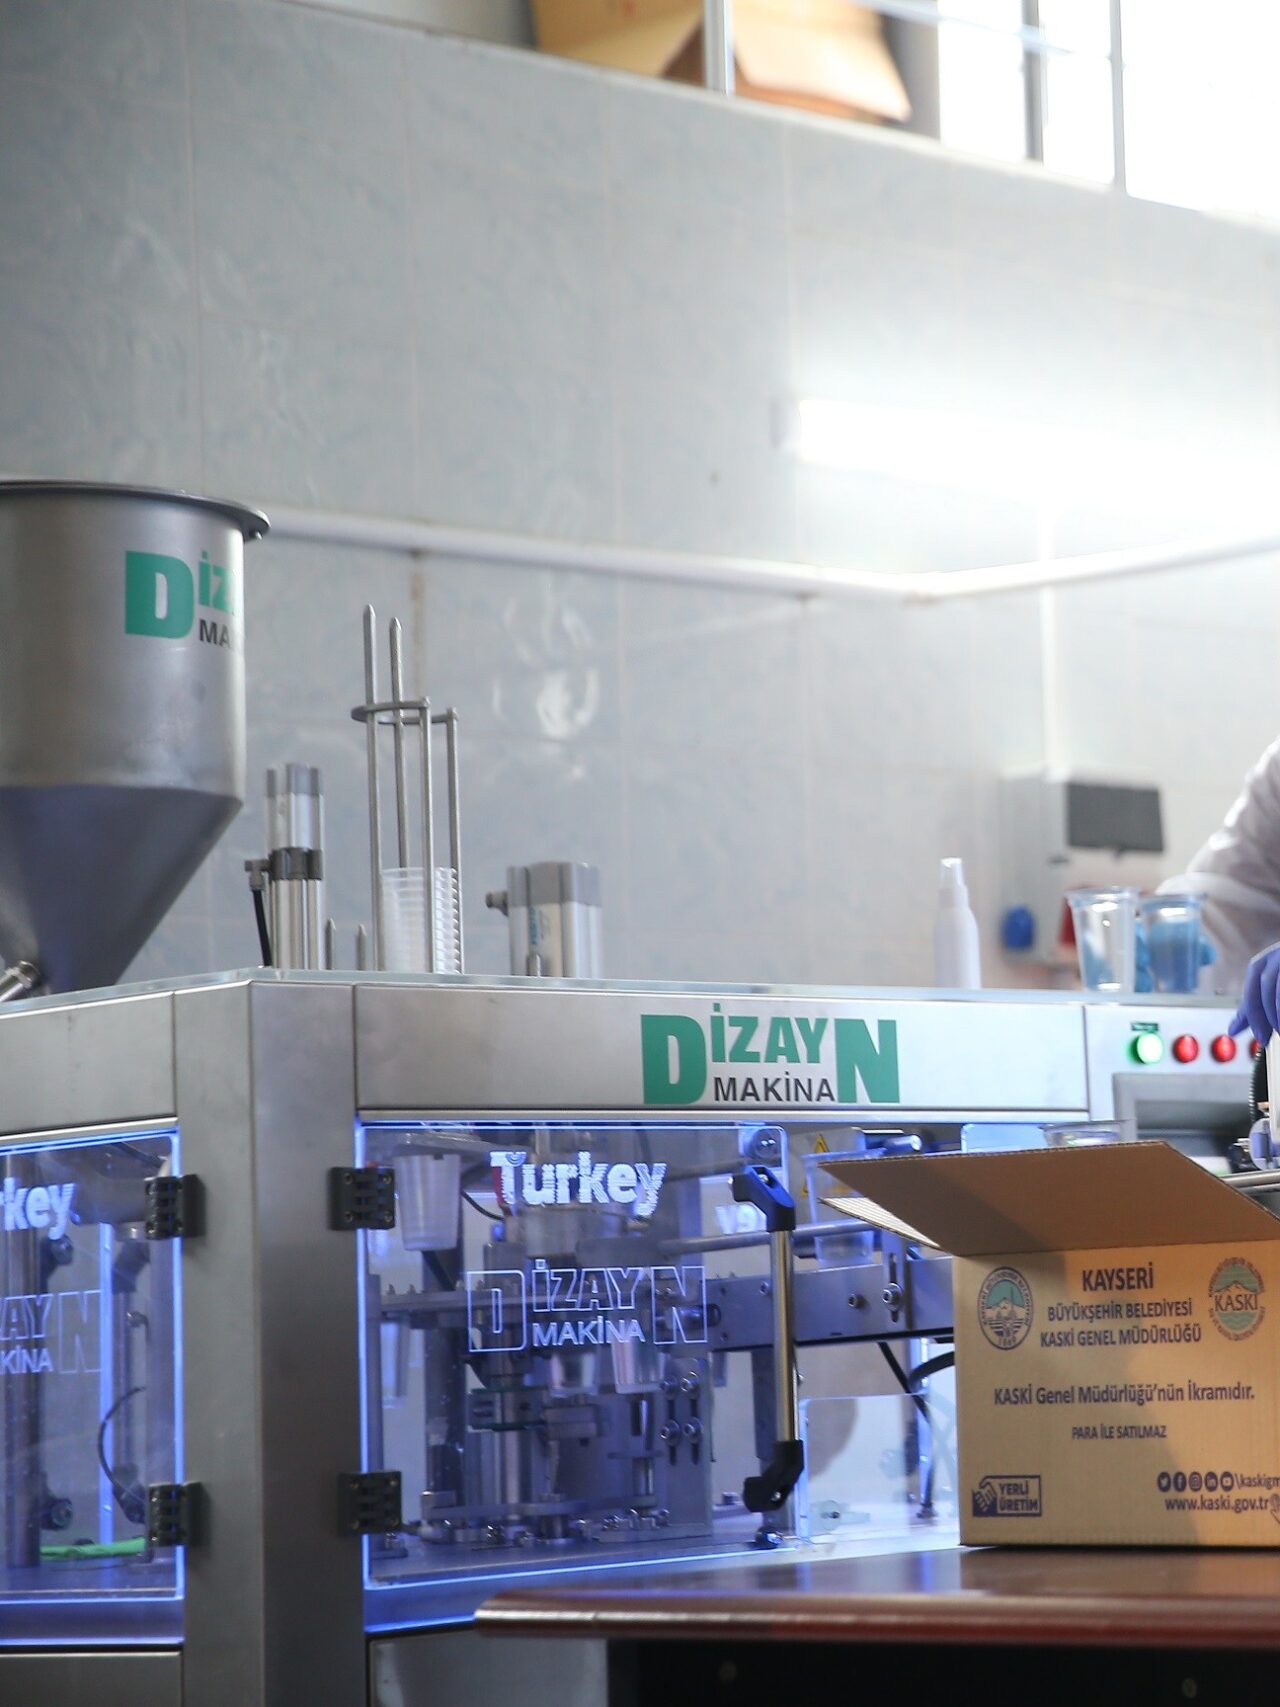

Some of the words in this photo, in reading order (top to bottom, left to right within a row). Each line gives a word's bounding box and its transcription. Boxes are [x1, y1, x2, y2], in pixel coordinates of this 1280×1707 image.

[640, 1003, 900, 1104] DİZAYN
[713, 1071, 836, 1102] MAKİNA
[490, 1152, 667, 1217] Turkey
[0, 1177, 75, 1240] key
[1082, 1263, 1154, 1292] KAYSERİ
[467, 1259, 708, 1352] DİZAYN
[1048, 1300, 1123, 1324] BÜYÜKŞEHİR
[1125, 1298, 1193, 1320] BELEDİYESİ
[532, 1316, 646, 1347] MAKİNA
[1040, 1328, 1075, 1348] KASKİ
[1078, 1330, 1116, 1346] GENEL
[1119, 1323, 1201, 1346] MÜDÜRLÜĞÜ
[994, 1384, 1032, 1405] KASKİ
[1036, 1386, 1075, 1404] Genel
[1072, 1426, 1098, 1440] PARA
[1100, 1423, 1114, 1439] İLE
[1116, 1425, 1167, 1439] SATILMAZ
[999, 1480, 1029, 1495] YERLİ
[1164, 1494, 1269, 1513] www.kaski.gov.tr
